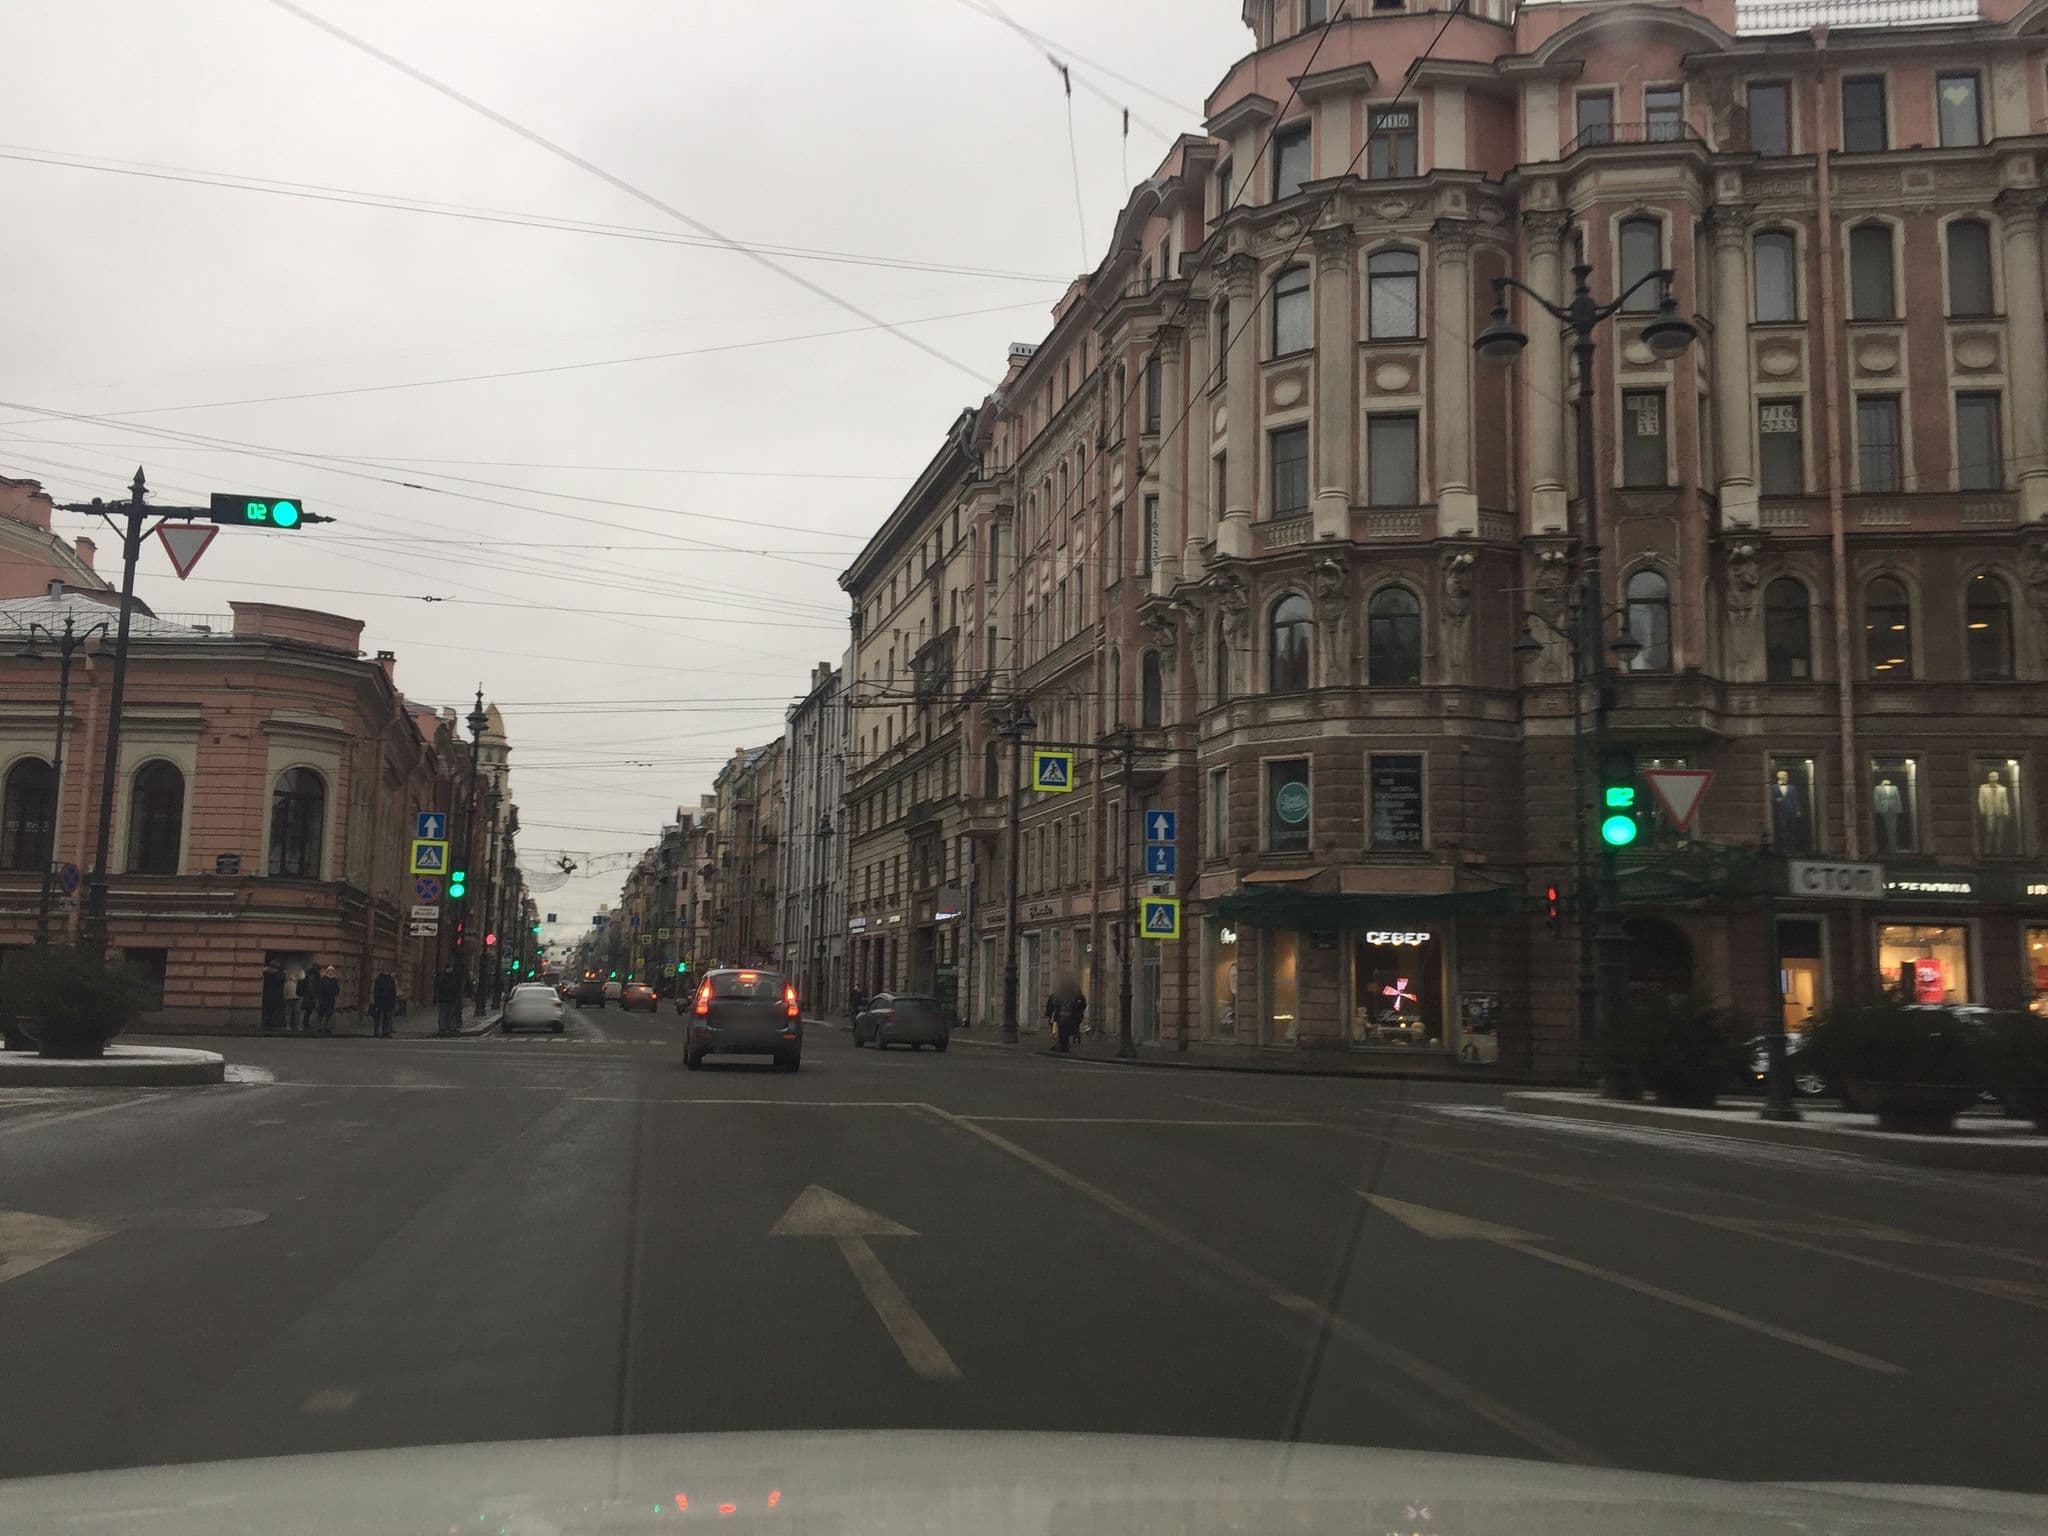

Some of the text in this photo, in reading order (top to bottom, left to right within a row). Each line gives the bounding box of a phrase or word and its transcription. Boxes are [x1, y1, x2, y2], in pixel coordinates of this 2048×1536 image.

[1761, 407, 1792, 418] 716
[1761, 419, 1797, 431] 5233
[247, 502, 267, 520] 02
[1803, 866, 1874, 892] СТОП
[1366, 931, 1431, 944] СЕВЕР
